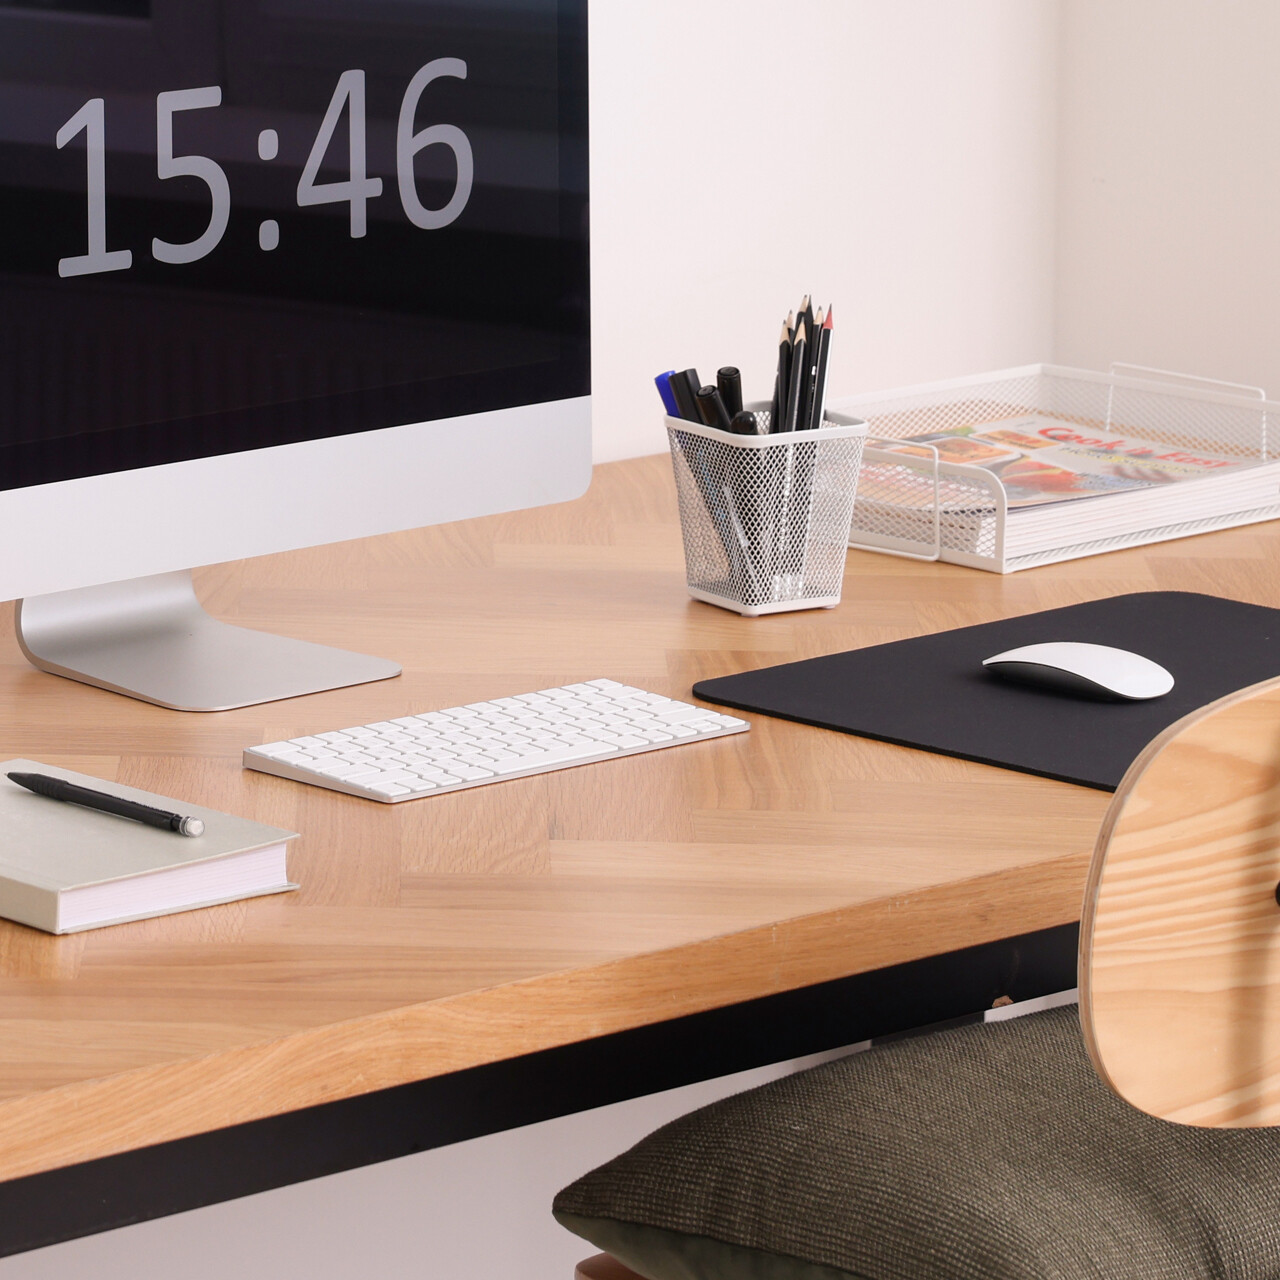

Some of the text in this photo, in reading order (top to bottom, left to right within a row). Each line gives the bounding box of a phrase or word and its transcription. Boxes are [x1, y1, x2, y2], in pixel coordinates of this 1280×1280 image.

[56, 58, 473, 277] 15:46
[1037, 426, 1125, 450] Cook
[1153, 451, 1239, 469] Easy
